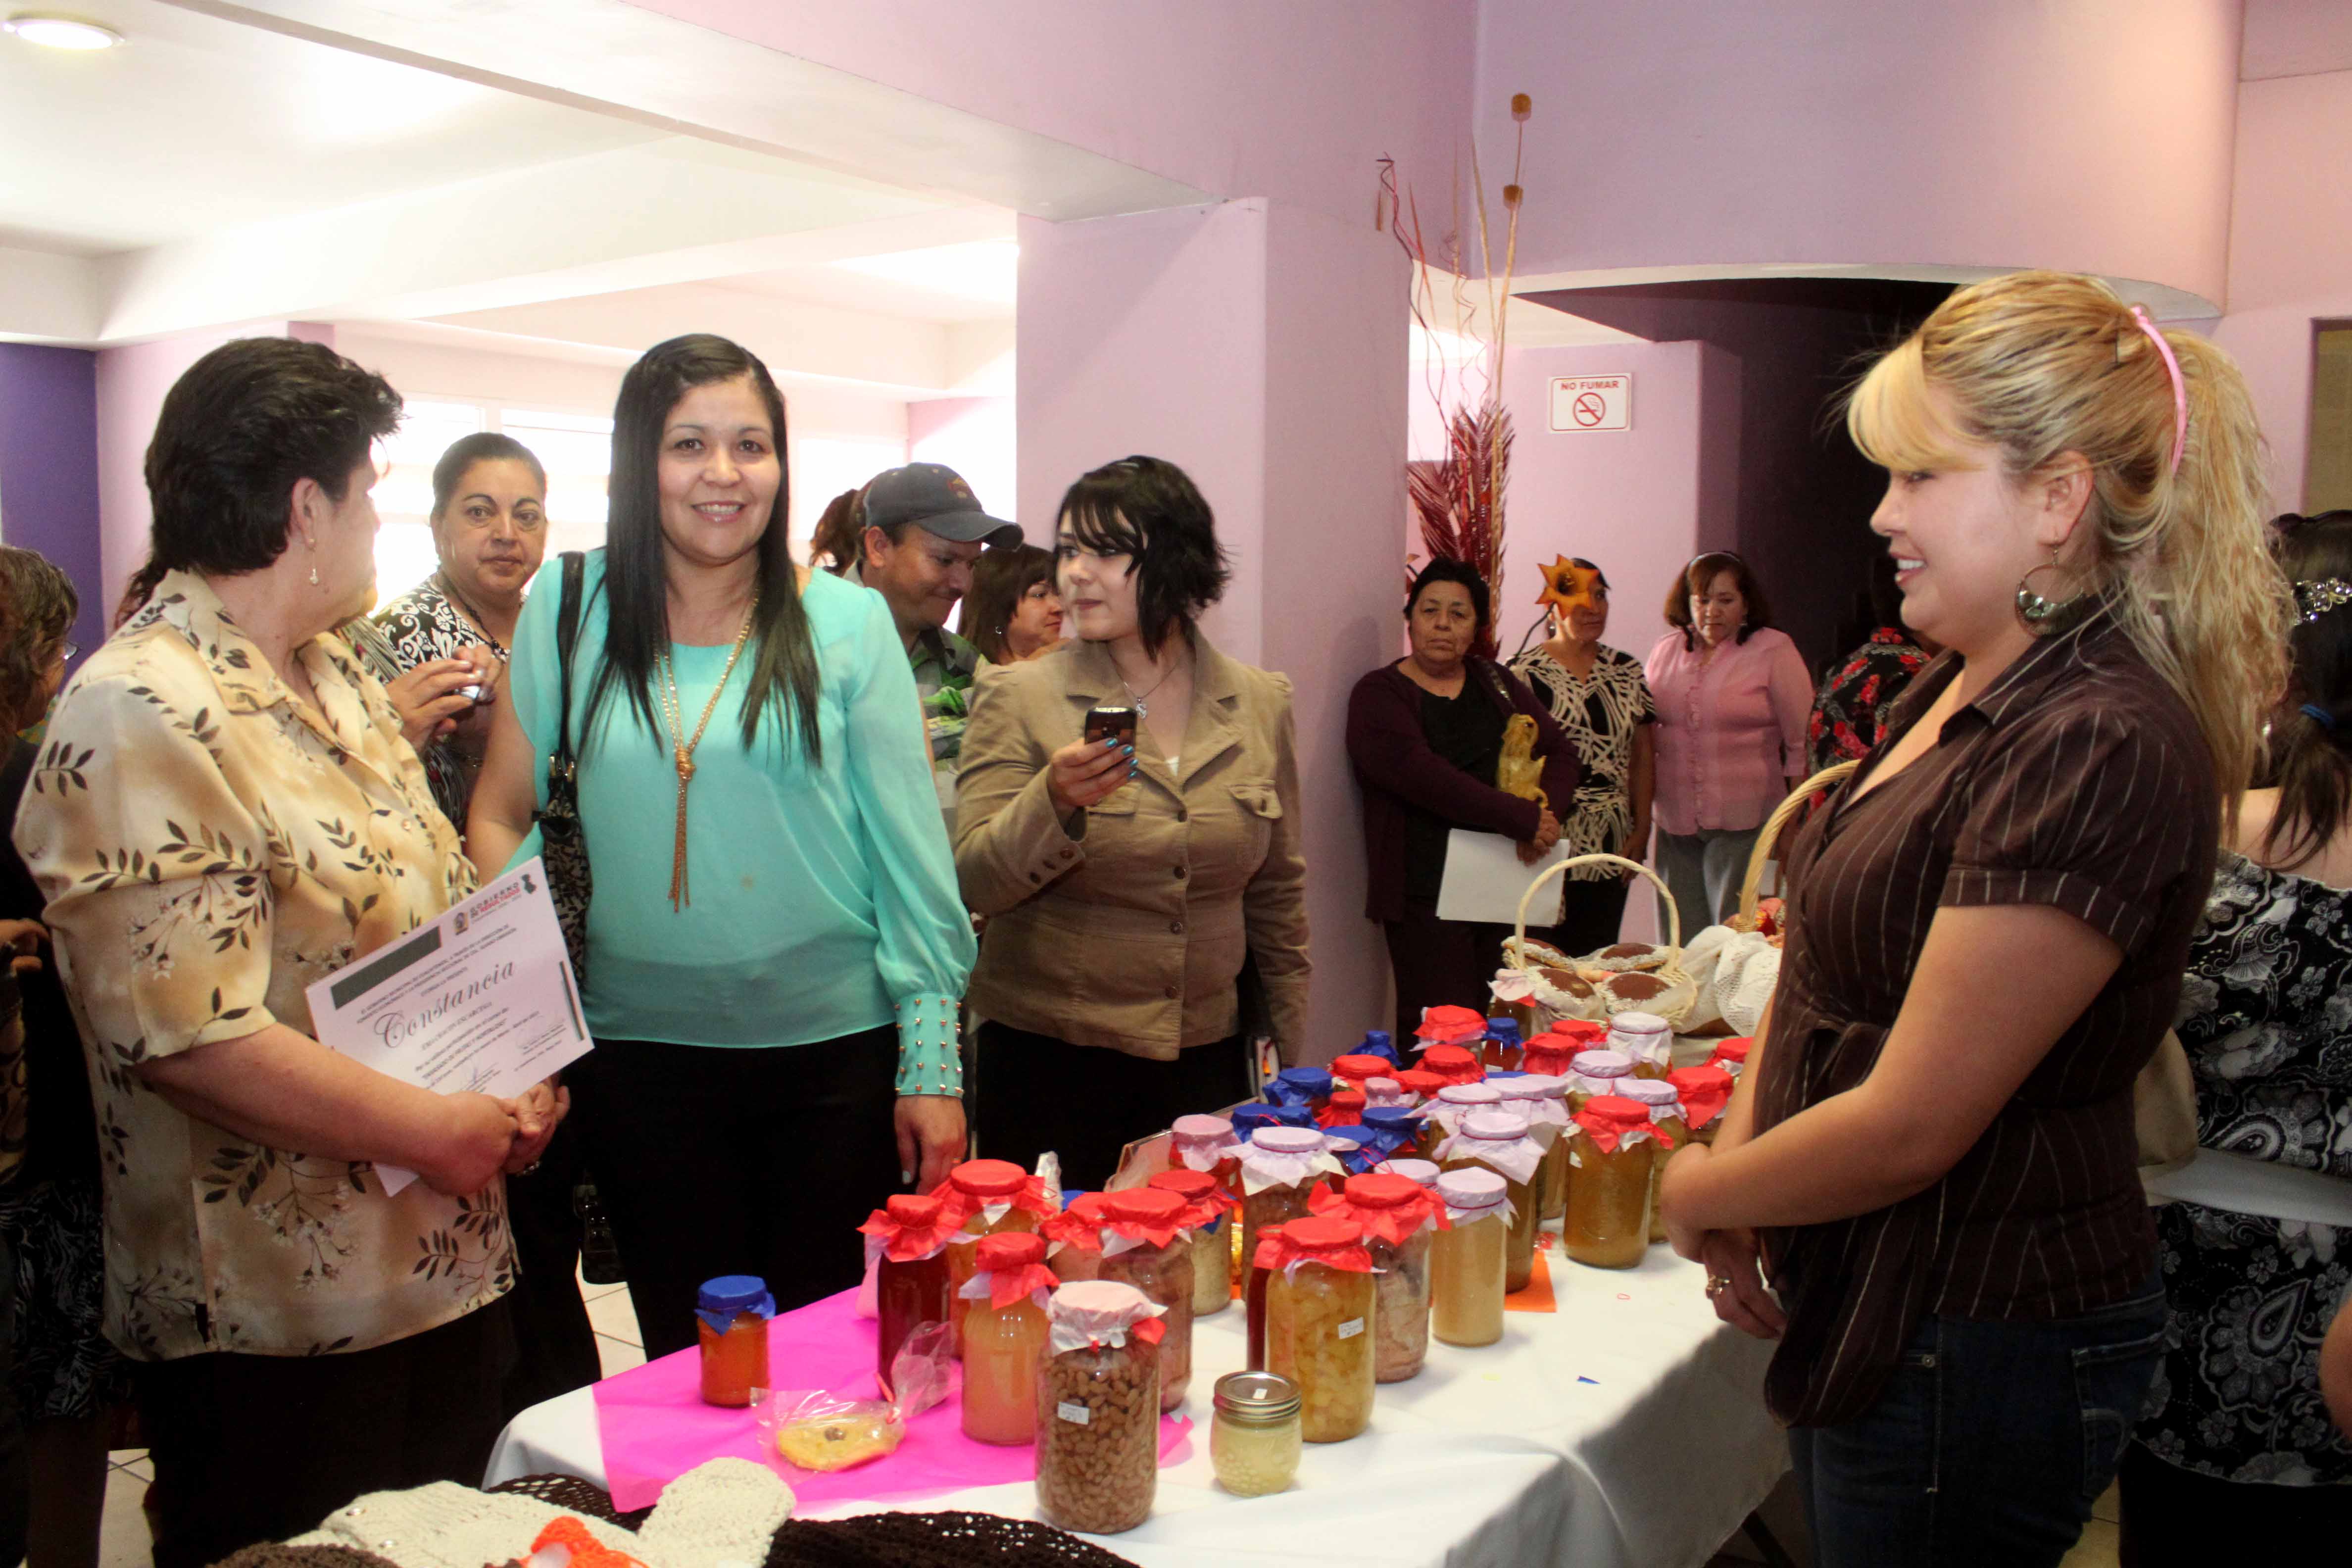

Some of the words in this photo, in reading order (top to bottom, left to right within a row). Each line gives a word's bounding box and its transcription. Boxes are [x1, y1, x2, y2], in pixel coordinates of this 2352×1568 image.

[1560, 382, 1576, 391] NO
[1580, 380, 1619, 390] FUMAR
[374, 961, 514, 1048] Constancia
